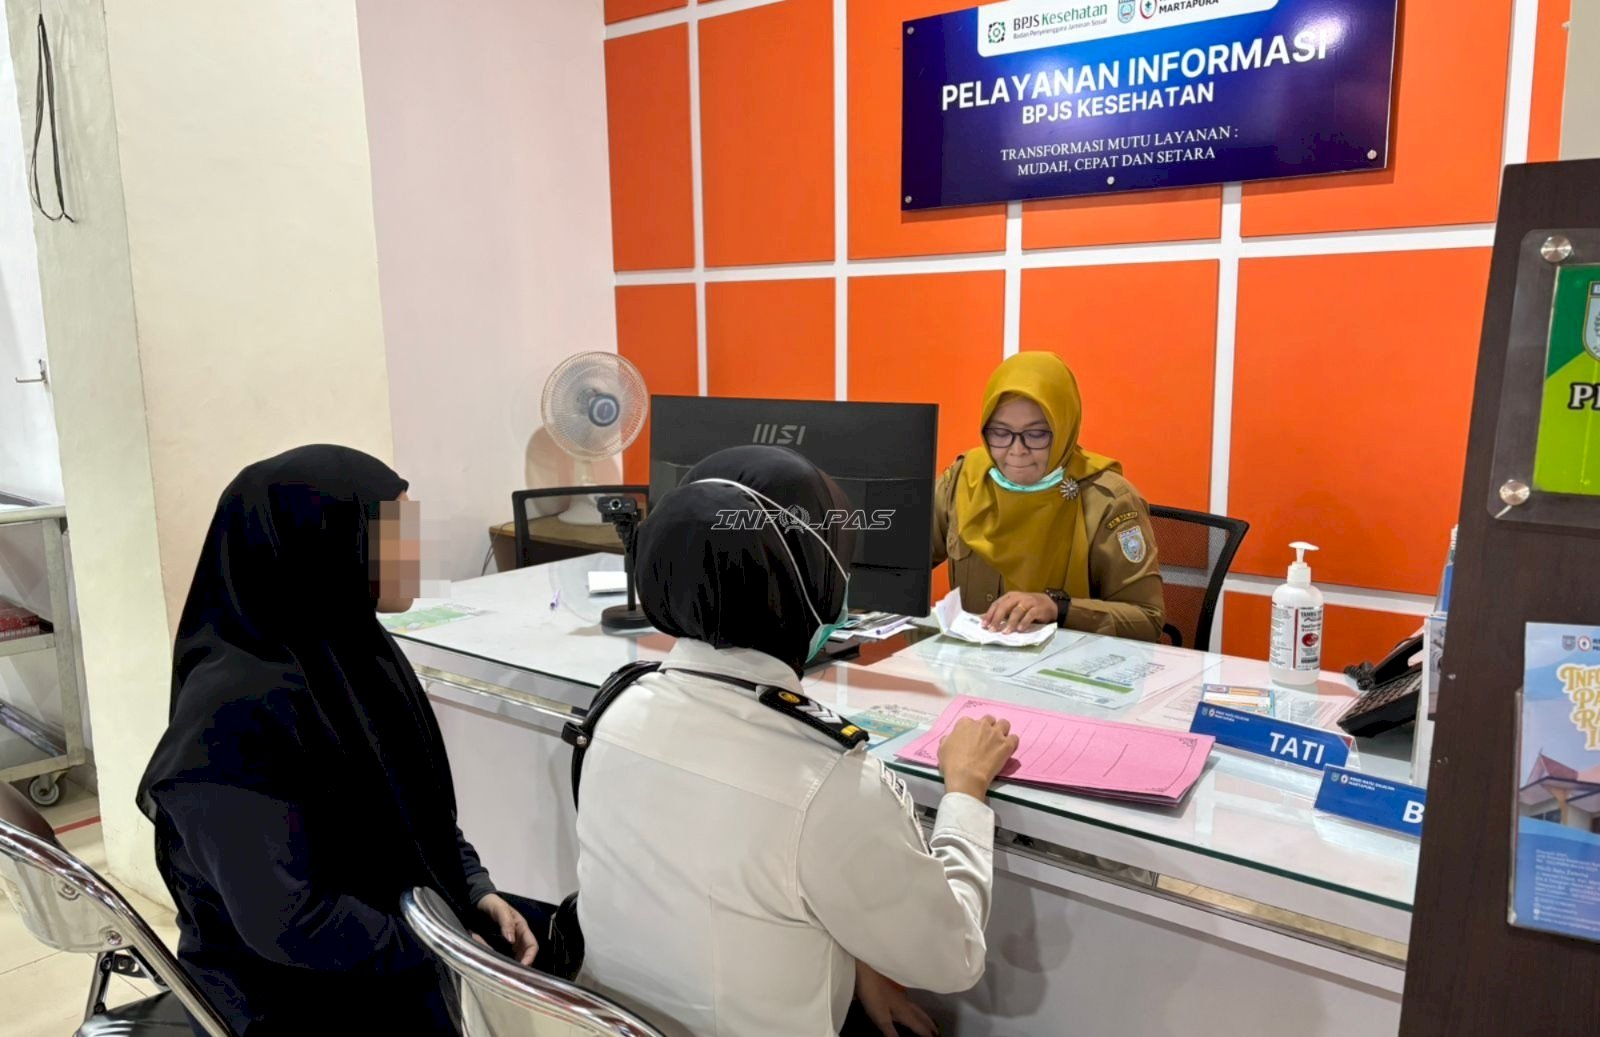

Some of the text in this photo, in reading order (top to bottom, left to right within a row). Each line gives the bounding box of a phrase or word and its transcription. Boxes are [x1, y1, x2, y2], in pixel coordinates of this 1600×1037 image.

[1013, 4, 1108, 31] BPJS Kesehatan
[942, 29, 1328, 111] PELAYANAN INFORMASI
[1022, 81, 1215, 125] BPJS KESEHATAN
[1000, 139, 1104, 161] TRANSFORMASI
[1107, 134, 1151, 150] MUTU
[1154, 126, 1231, 146] LAYANAN
[1017, 147, 1216, 177] MUDAH, CEPAT DAN SETARA
[752, 424, 806, 445] MSI
[1270, 732, 1325, 764] TATI
[1402, 800, 1425, 824] B
